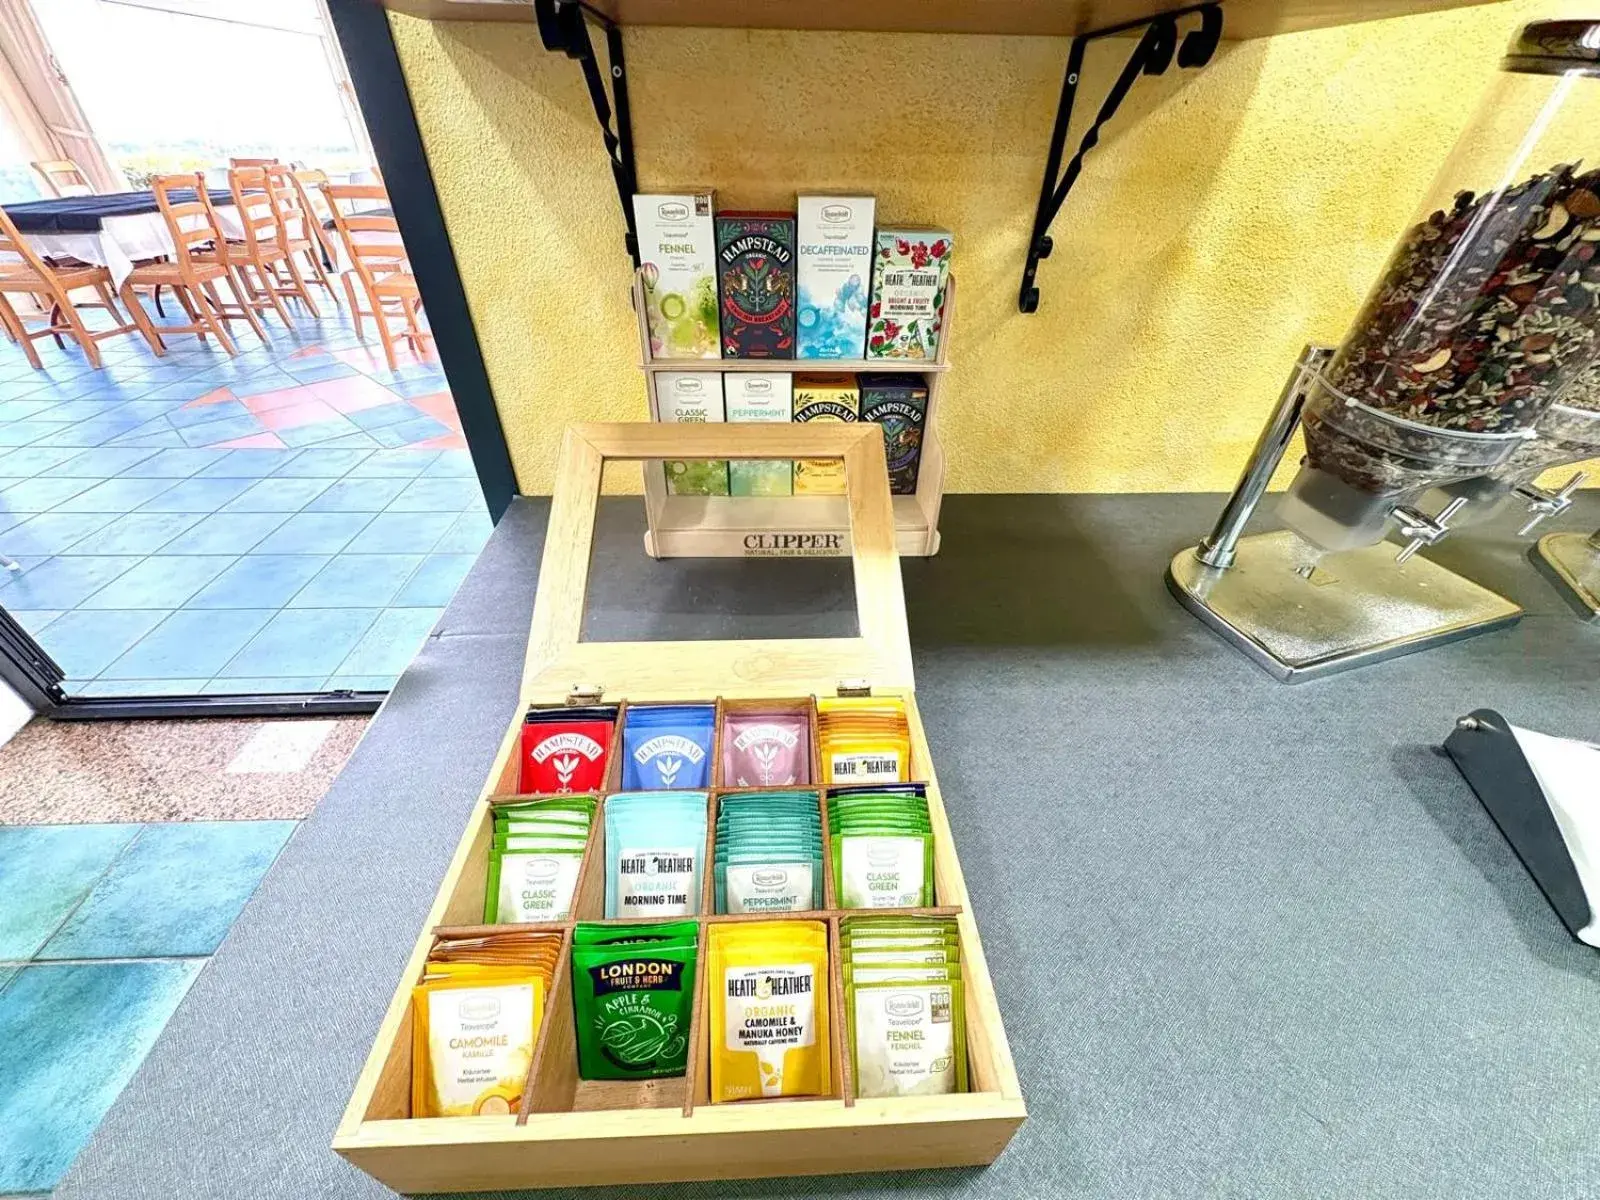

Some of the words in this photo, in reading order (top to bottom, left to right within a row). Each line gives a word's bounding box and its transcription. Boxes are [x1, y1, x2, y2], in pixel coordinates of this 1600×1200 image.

[659, 244, 696, 254] FENNEL
[722, 236, 791, 263] HAMPSTEAD
[800, 245, 869, 256] DECAFFEINATED
[884, 274, 904, 286] HEATH
[675, 408, 708, 417] CLASSIC
[732, 409, 787, 418] PEPPERMINT
[796, 402, 857, 423] HAMPSTEAD
[864, 402, 923, 423] HAMPSTEAD
[535, 734, 600, 758] HAMPSTEAD
[834, 761, 856, 775] HEATH
[866, 759, 897, 774] HEATHER
[621, 858, 645, 875] HEATH
[657, 856, 694, 873] HEATHER
[866, 872, 901, 882] CLASSIC
[868, 881, 899, 892] GREEN
[521, 889, 557, 899] CLASSIC
[624, 894, 665, 906] MORNING
[667, 893, 688, 905] TIME
[522, 900, 554, 911] GREEN
[743, 895, 798, 908] PEPPERMINT
[600, 962, 673, 980] LONDON
[611, 975, 633, 988] FRUIT
[642, 974, 664, 985] HERB
[728, 978, 757, 998] HEATH
[770, 974, 812, 996] HEATHER
[605, 993, 638, 1014] APPLE
[640, 993, 651, 1005] &
[619, 1005, 662, 1020] CINNAMON
[744, 1004, 795, 1018] ORGANIC
[744, 1016, 788, 1028] CAMOMILE
[789, 1016, 797, 1026] &
[738, 1028, 774, 1040] MANUKA
[775, 1026, 803, 1038] HONEY
[886, 1030, 926, 1042] FENNEL
[449, 1034, 509, 1050] CAMOMILE
